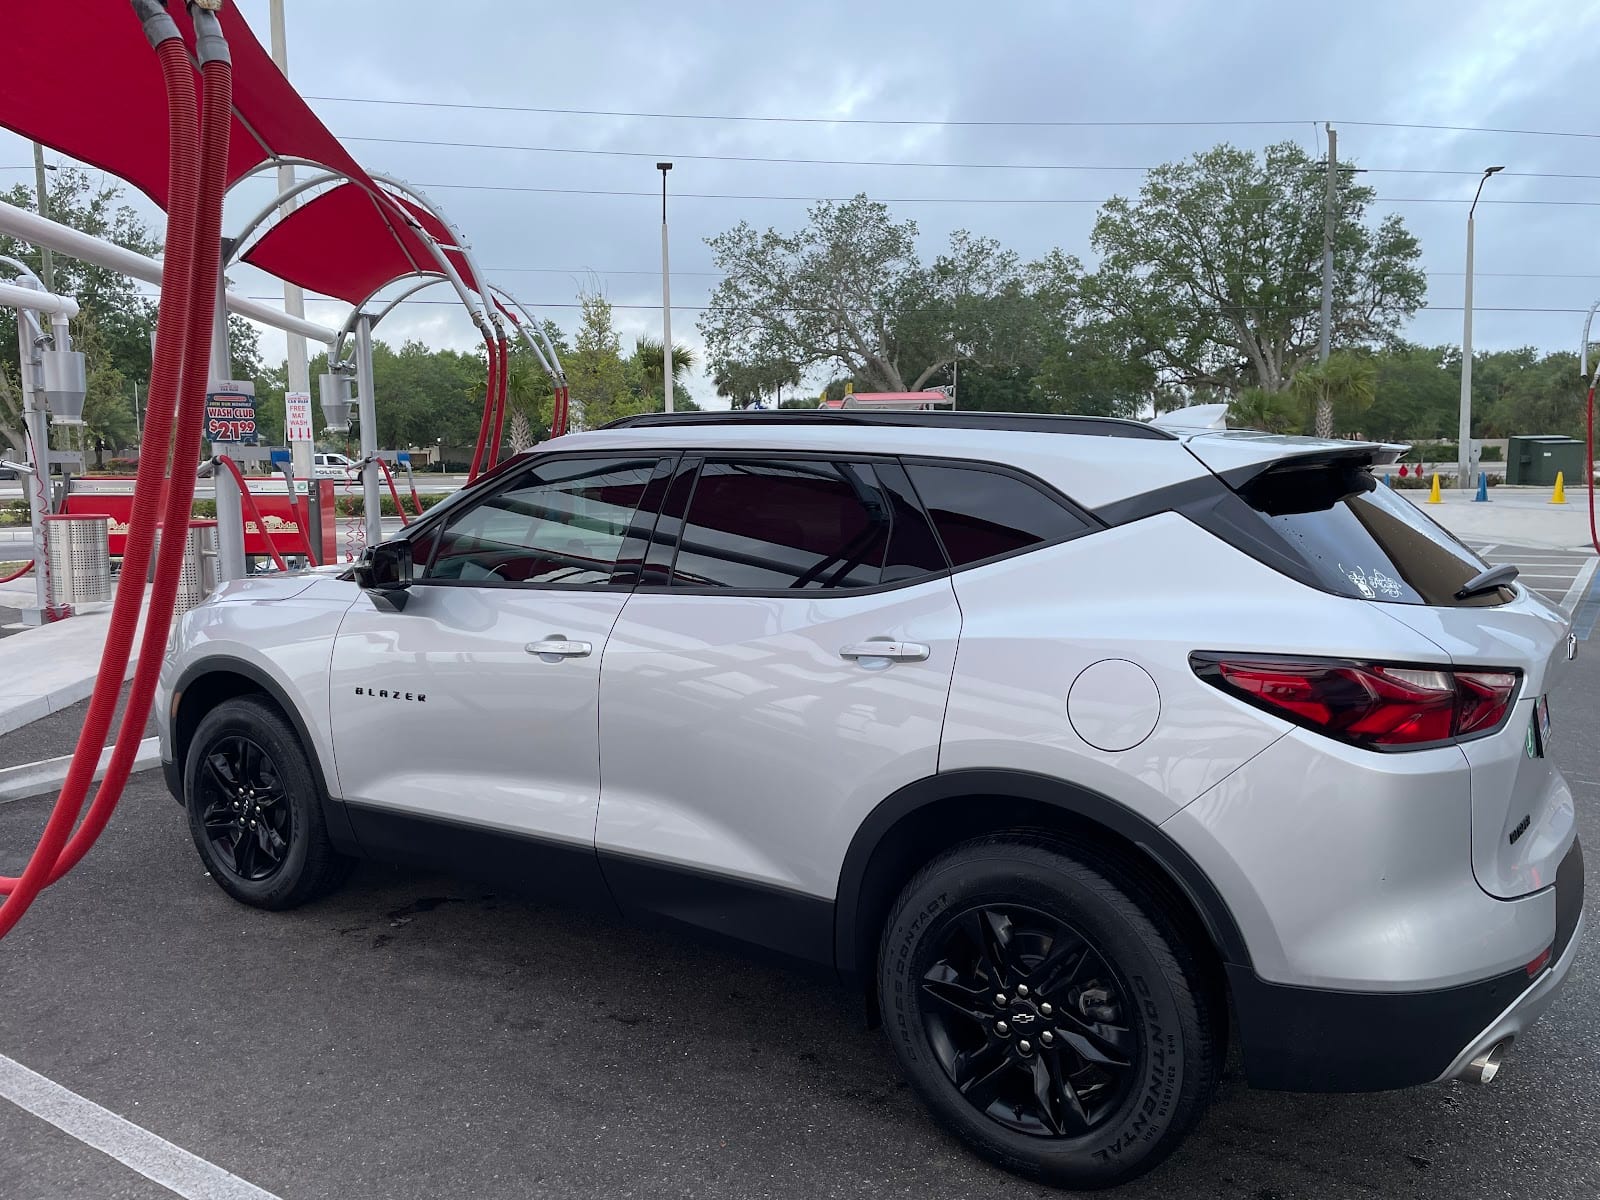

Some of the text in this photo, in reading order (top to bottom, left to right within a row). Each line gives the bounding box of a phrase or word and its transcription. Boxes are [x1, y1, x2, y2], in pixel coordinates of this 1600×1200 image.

[207, 407, 255, 419] WASH CLUB
[355, 686, 427, 702] BLAZER
[1091, 975, 1165, 1161] CONTINENTAL
